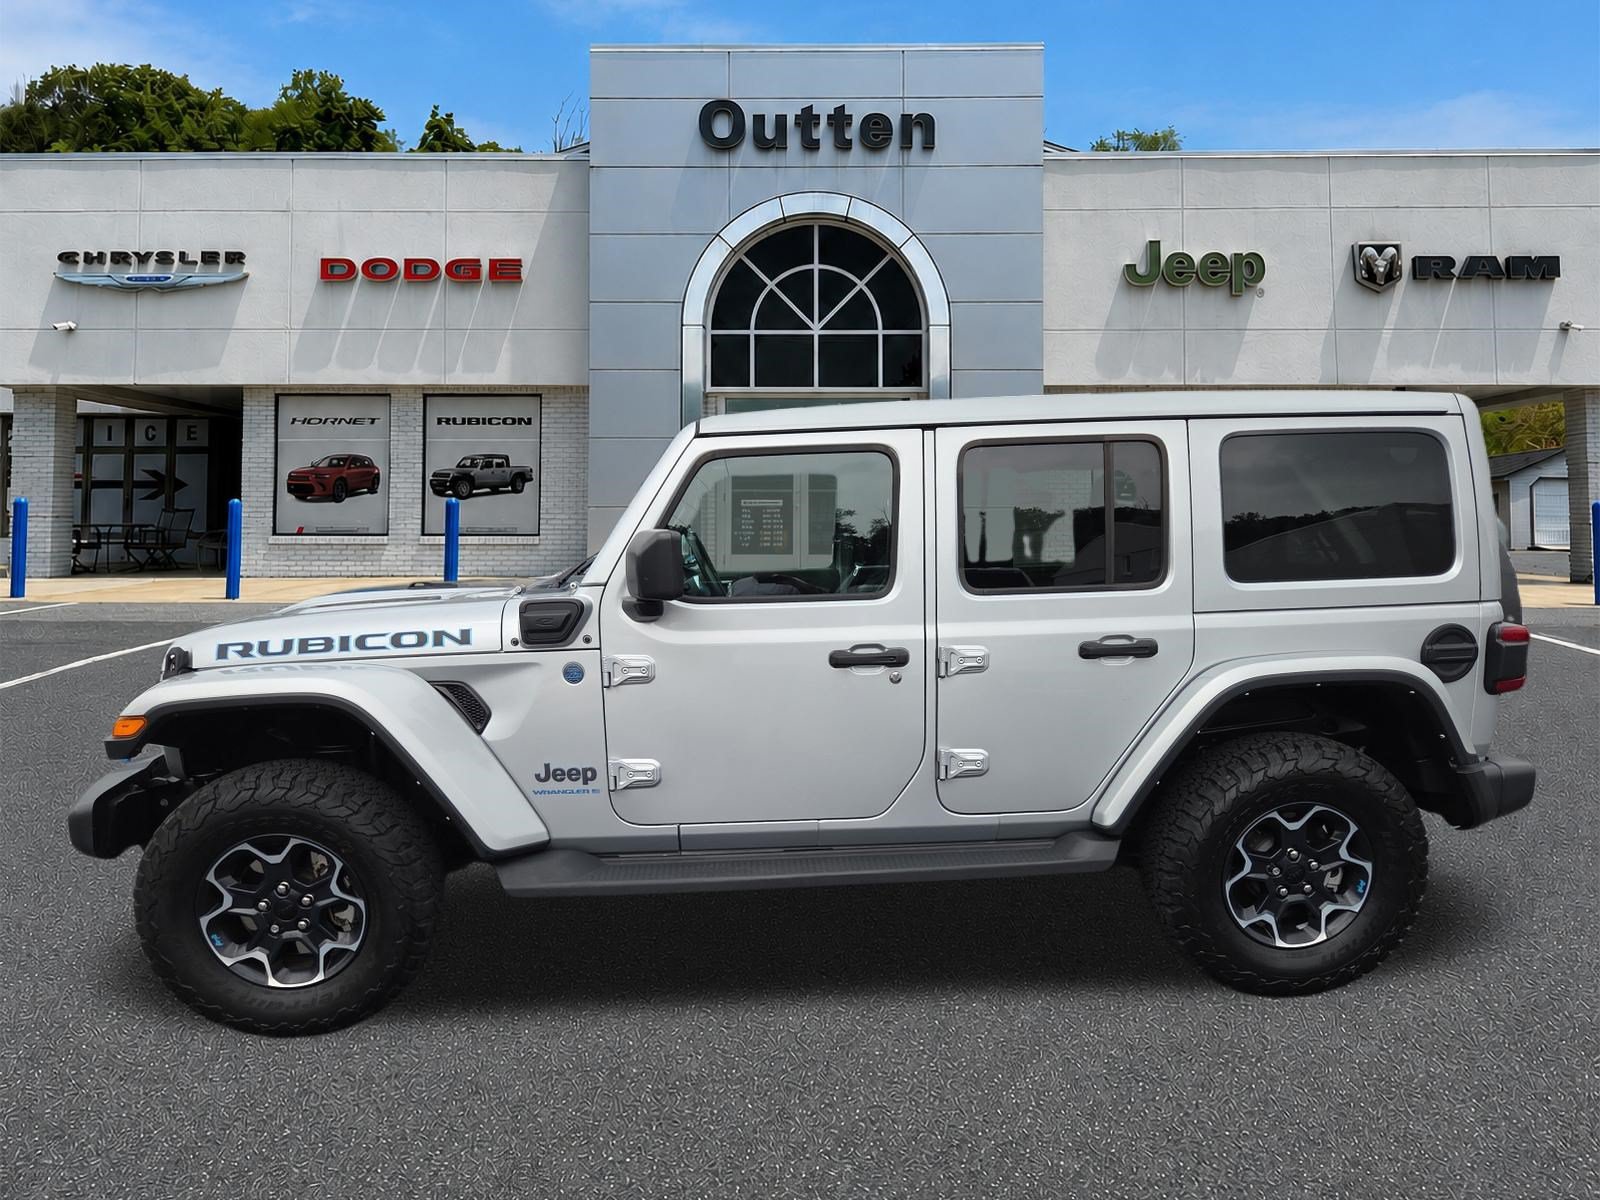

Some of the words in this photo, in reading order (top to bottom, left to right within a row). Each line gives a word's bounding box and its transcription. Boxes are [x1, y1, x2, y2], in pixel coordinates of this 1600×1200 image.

[698, 98, 936, 151] Outten
[56, 250, 247, 266] CHRYSLER
[1123, 239, 1266, 297] Jeep
[1411, 255, 1561, 280] RAM
[320, 257, 523, 283] DODGE
[290, 416, 381, 426] HORNET
[436, 416, 533, 426] RUBICON
[216, 628, 472, 660] RUBICON
[534, 763, 597, 785] Jeep
[533, 788, 590, 796] WRANGLER
